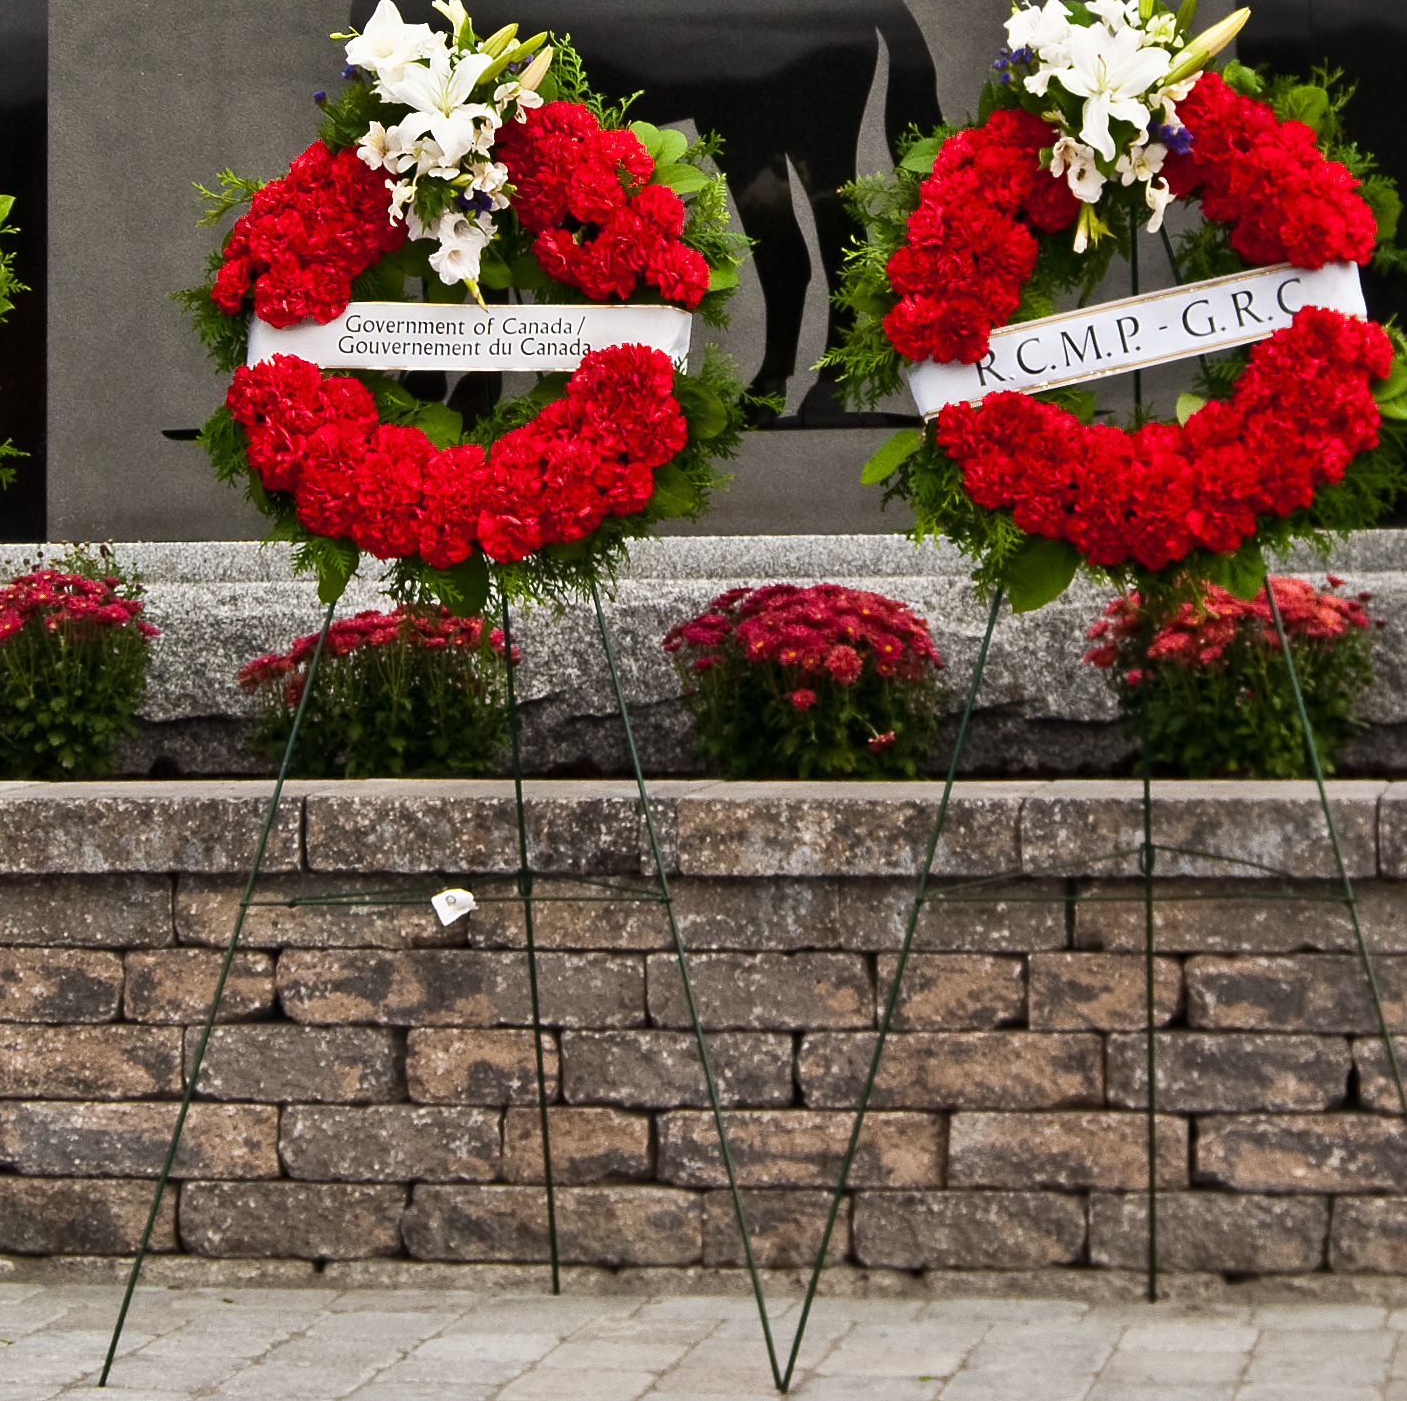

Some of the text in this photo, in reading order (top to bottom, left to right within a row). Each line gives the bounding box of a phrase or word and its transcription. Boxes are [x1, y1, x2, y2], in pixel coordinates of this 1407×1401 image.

[345, 314, 465, 336] Government
[472, 317, 495, 335] of
[338, 335, 592, 357] Gouvernement du Canada
[976, 315, 1141, 387] R.C.M.P.
